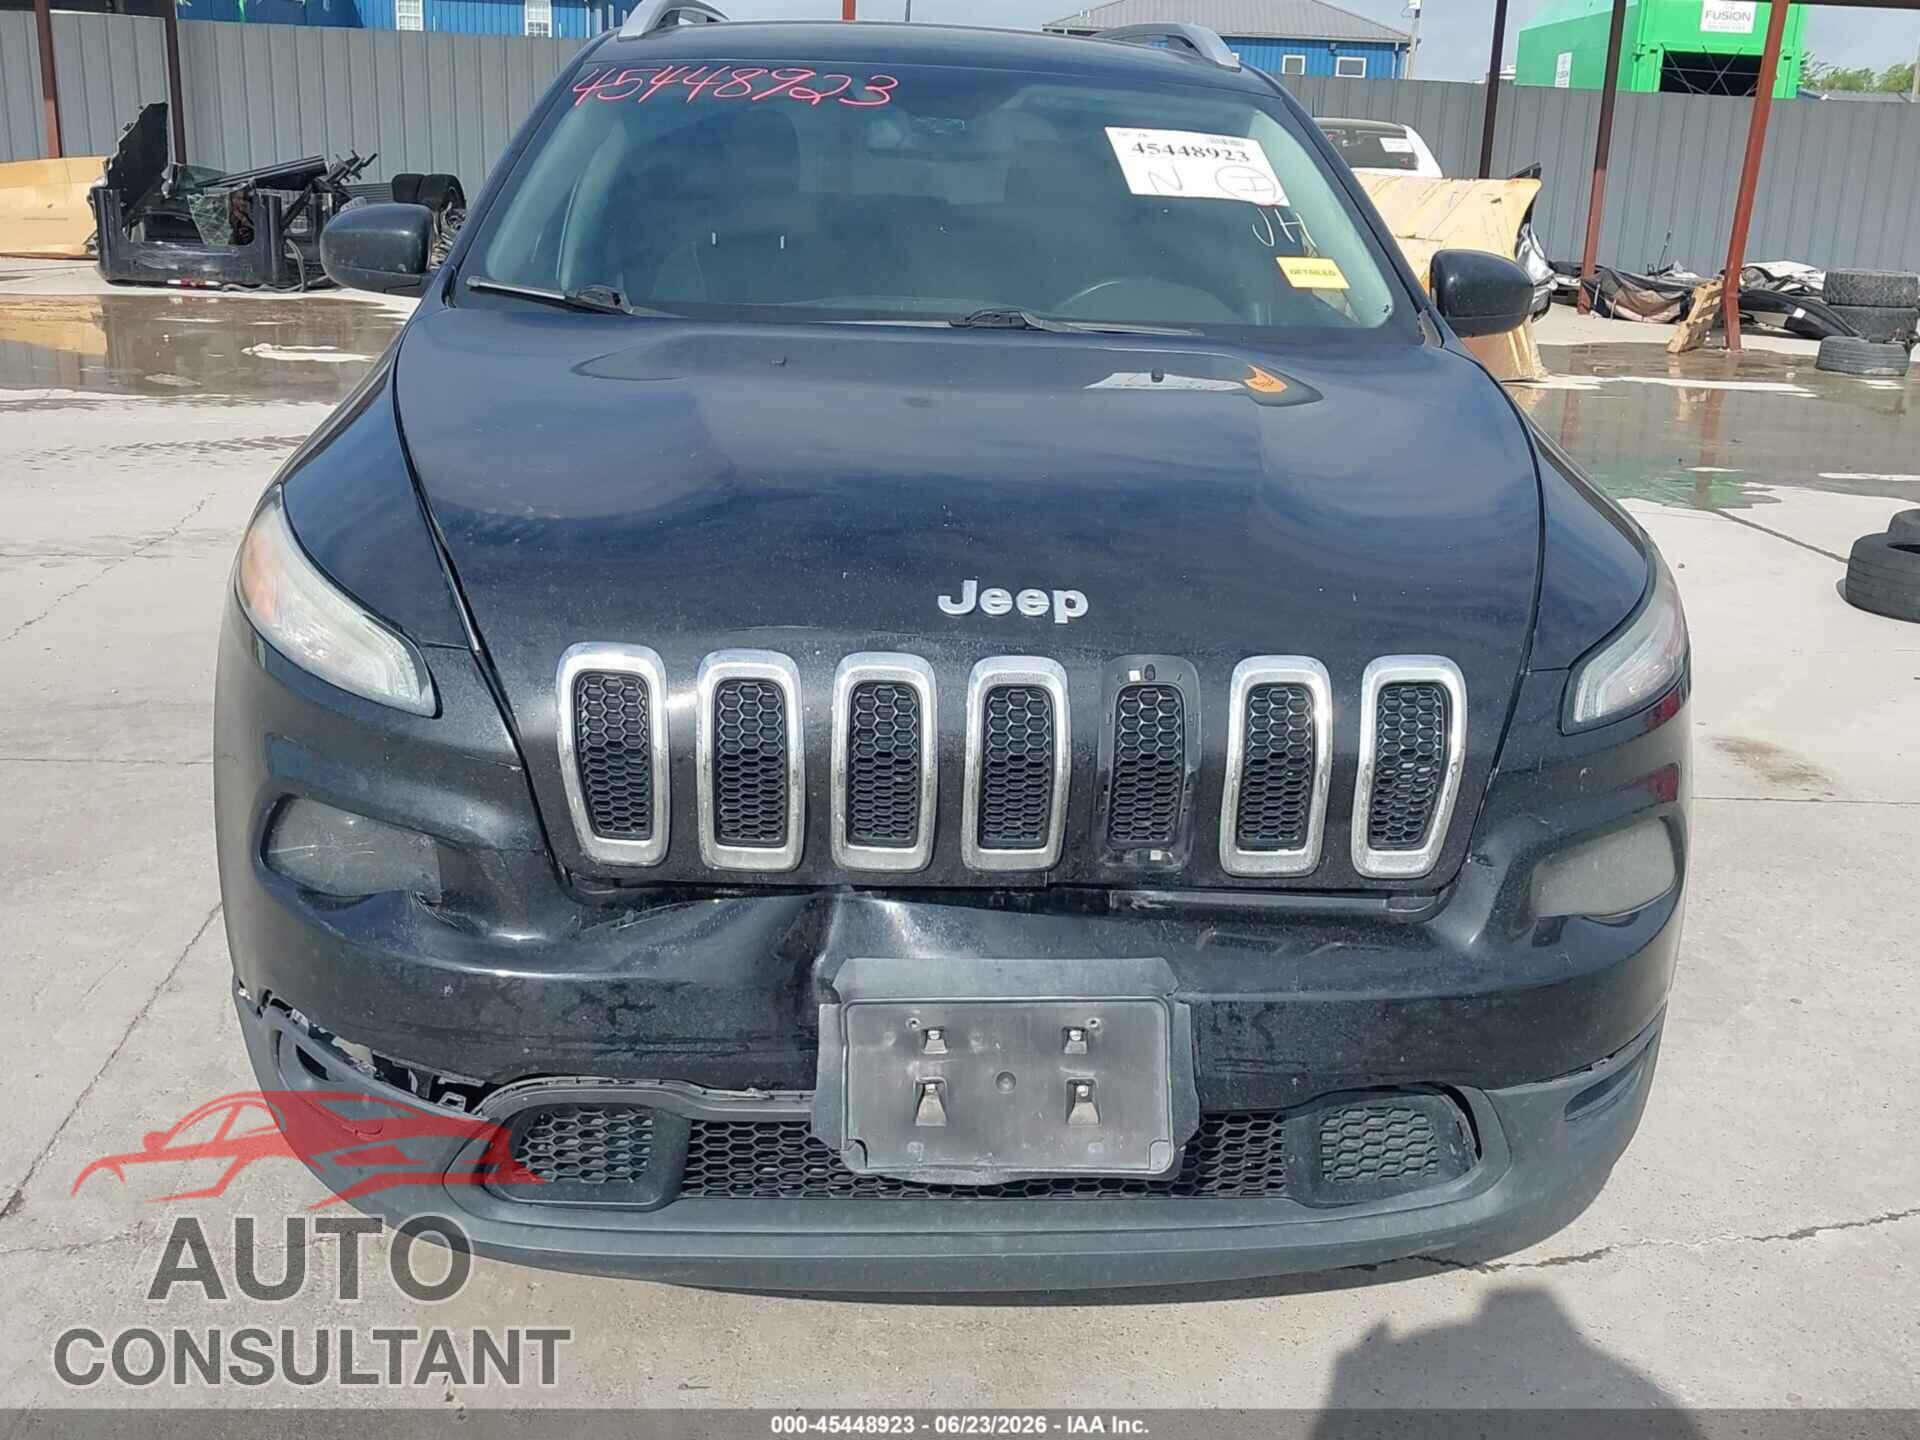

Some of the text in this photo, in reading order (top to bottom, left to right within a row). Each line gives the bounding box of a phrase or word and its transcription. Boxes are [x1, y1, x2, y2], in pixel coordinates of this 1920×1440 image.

[1705, 10, 1751, 22] FUSION
[572, 65, 898, 106] 45448923
[1130, 141, 1250, 162] 45448923
[937, 579, 1089, 624] Jeep
